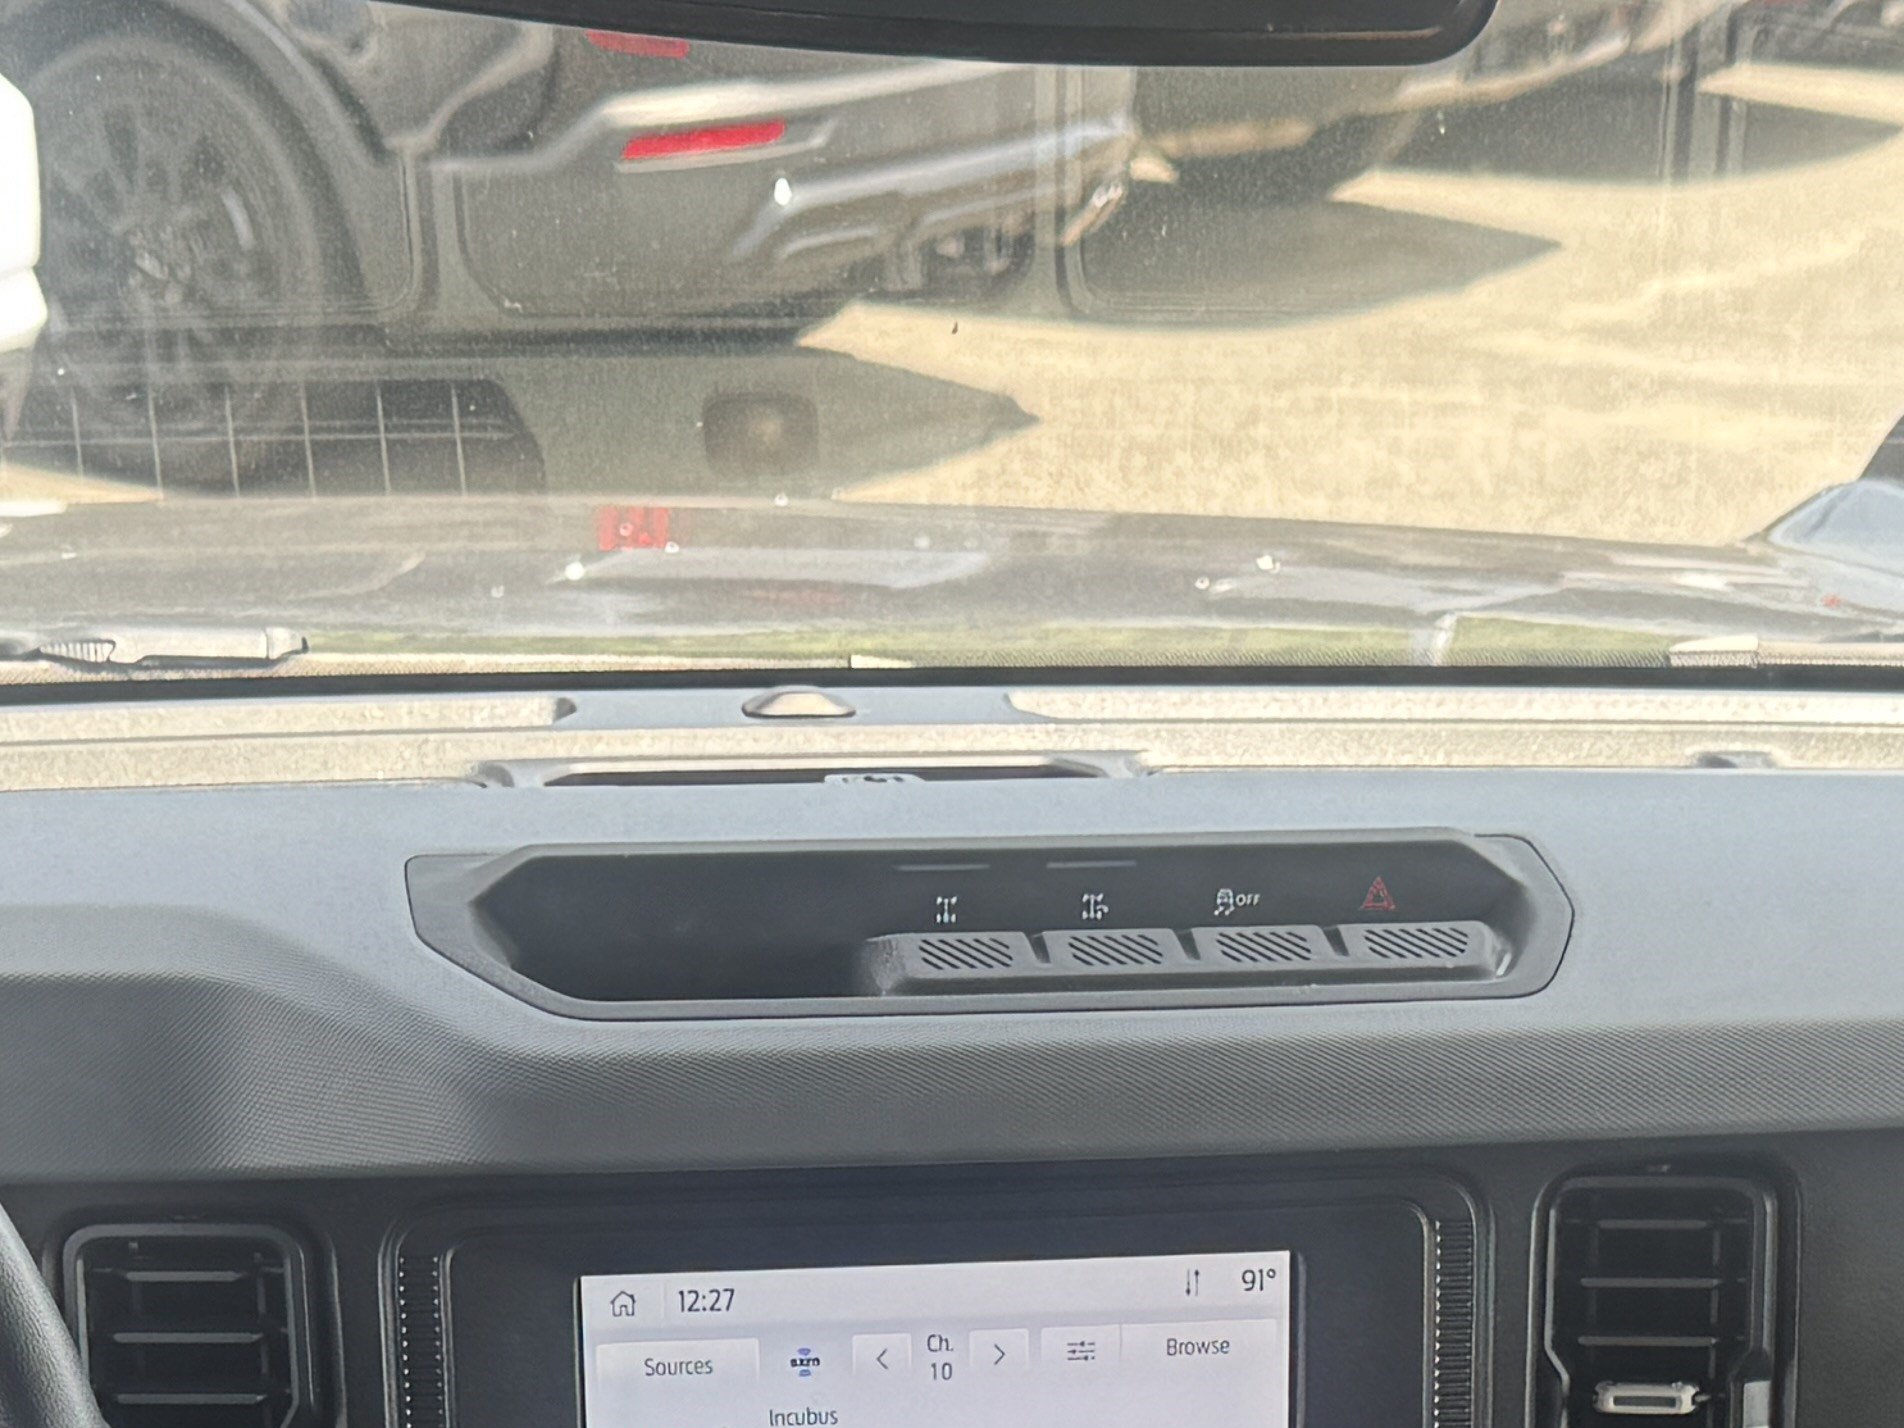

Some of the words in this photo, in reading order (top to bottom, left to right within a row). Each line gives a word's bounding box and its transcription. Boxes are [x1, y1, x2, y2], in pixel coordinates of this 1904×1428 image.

[1235, 891, 1261, 907] OFF
[678, 1288, 736, 1313] 12:27
[926, 1333, 954, 1353] Ch.
[1165, 1338, 1231, 1356] Browse
[643, 1356, 714, 1378] Sources
[929, 1363, 953, 1382] 10
[768, 1407, 839, 1427] Incubus
